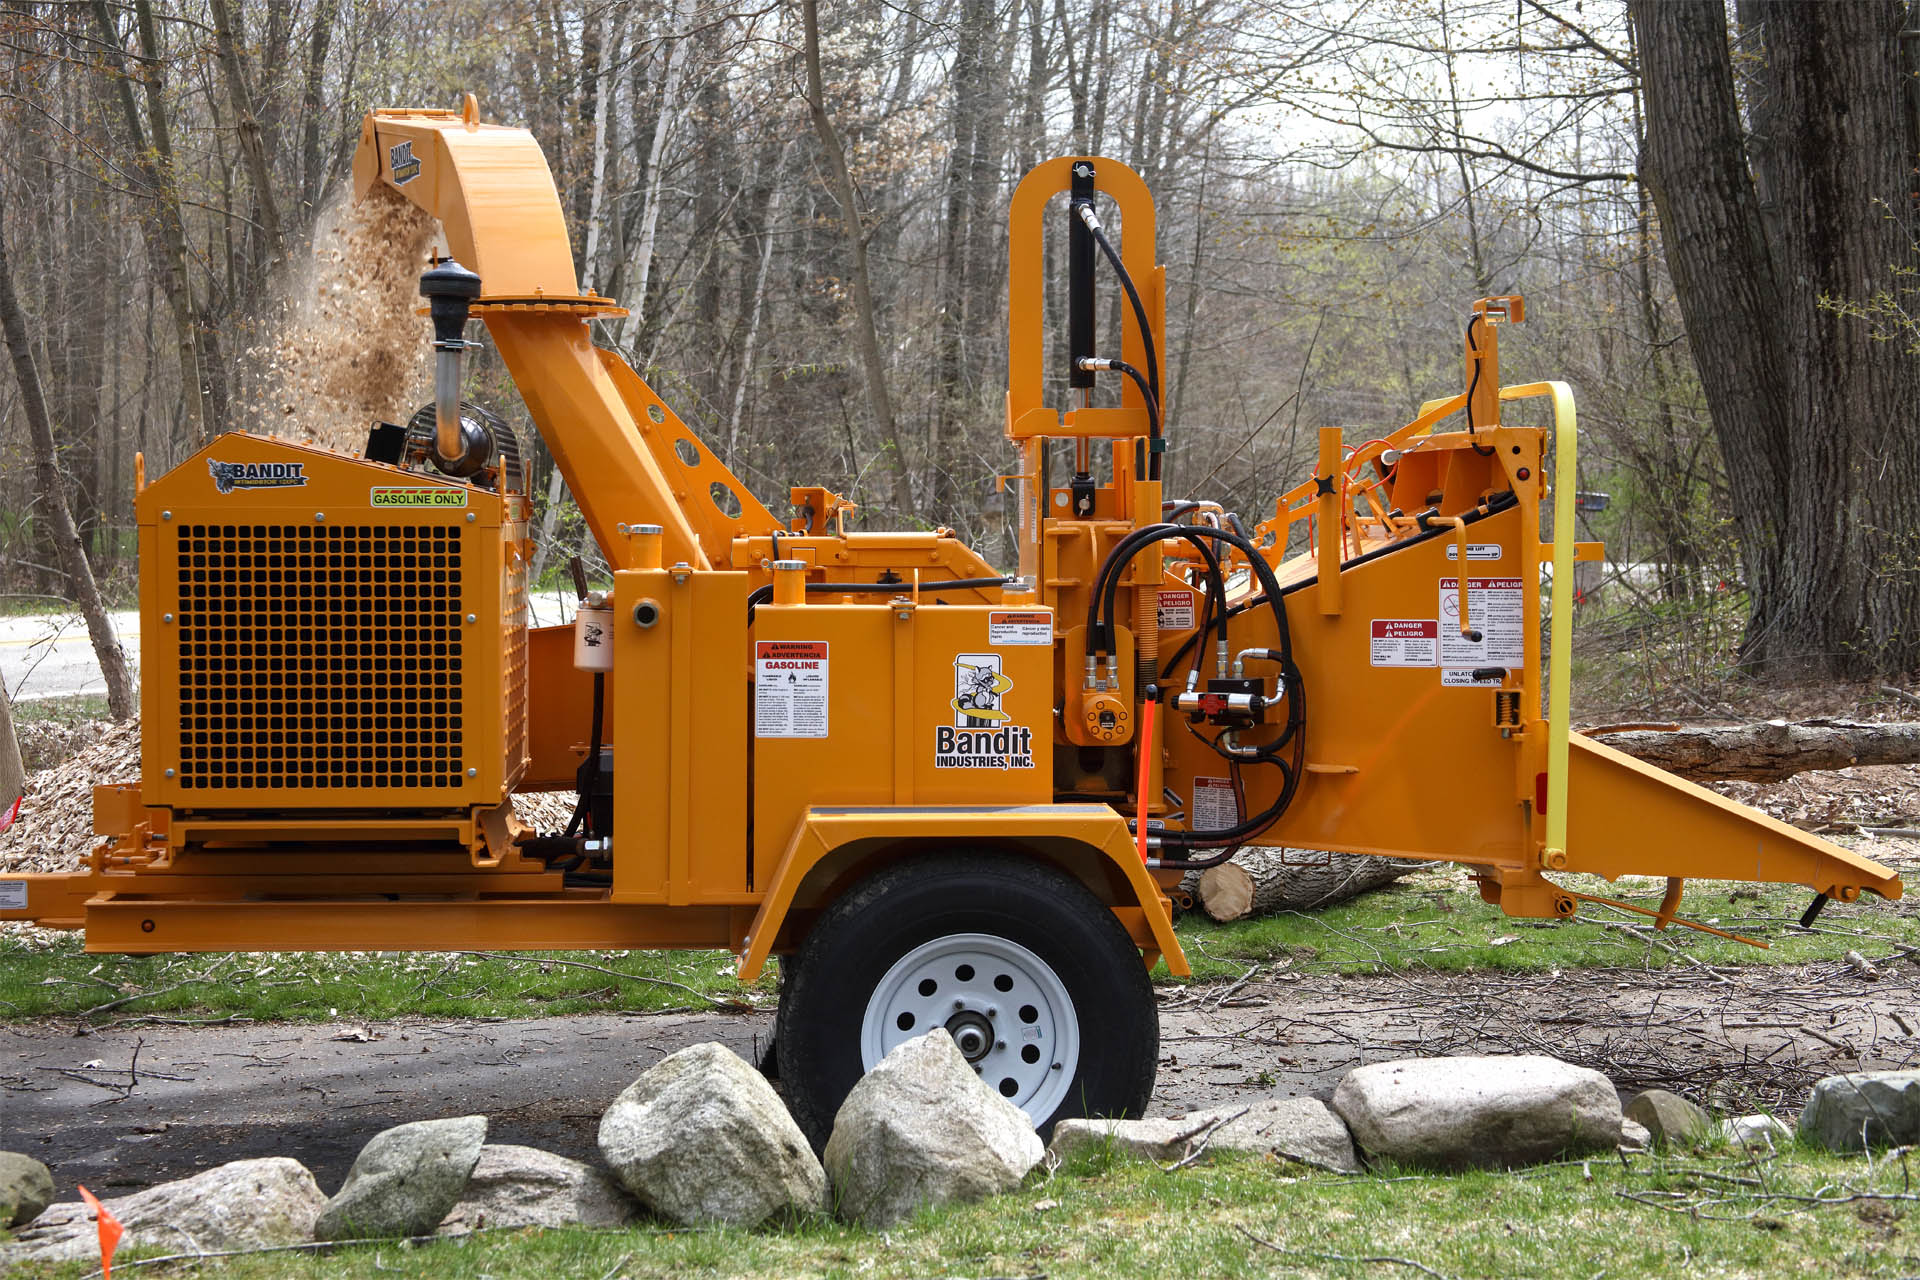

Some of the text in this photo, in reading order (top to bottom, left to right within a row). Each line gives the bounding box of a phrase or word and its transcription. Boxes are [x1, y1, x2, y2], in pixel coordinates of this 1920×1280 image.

[233, 463, 303, 478] BANDIT
[374, 494, 464, 504] GASOLINE ONLY
[765, 661, 820, 670] GASOLINE
[937, 727, 1031, 754] Bandit
[936, 756, 1034, 769] INDUSTRIES, INC.
